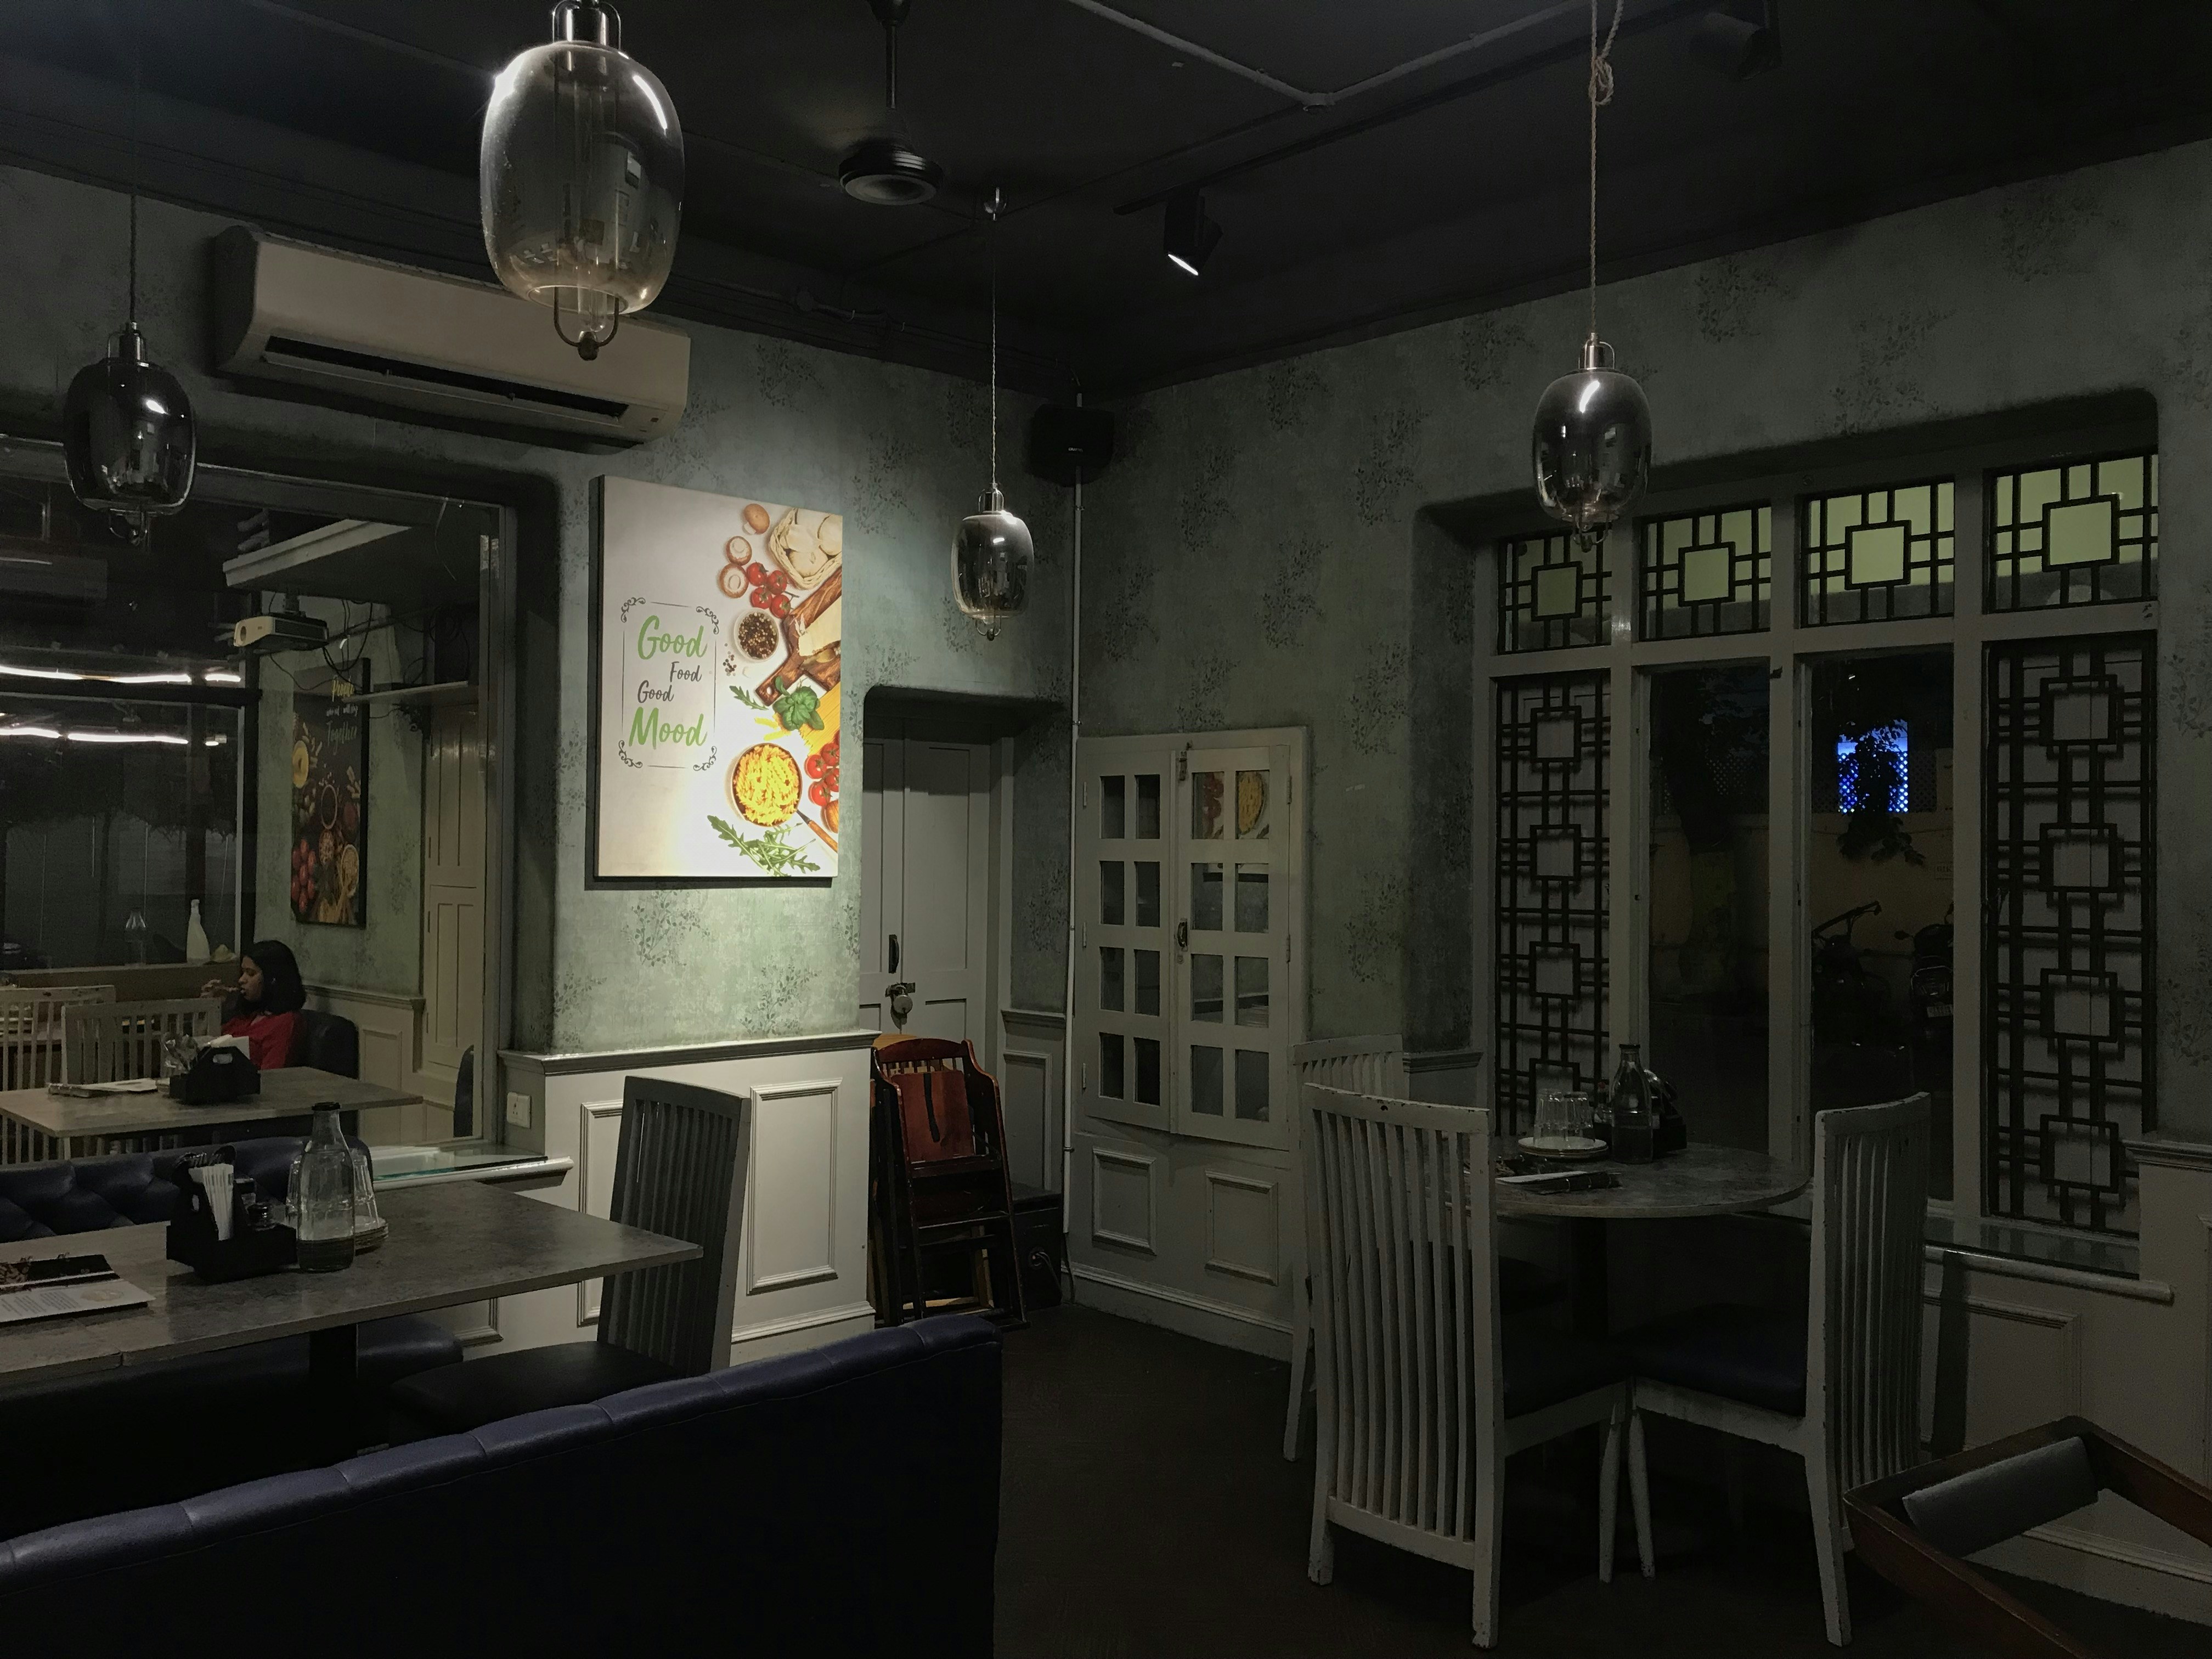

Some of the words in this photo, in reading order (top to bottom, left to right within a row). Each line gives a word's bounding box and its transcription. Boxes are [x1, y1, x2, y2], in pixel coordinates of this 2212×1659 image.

[637, 615, 708, 660] Good
[669, 661, 702, 682] Food
[637, 680, 674, 703] Good
[628, 707, 708, 750] Mood
